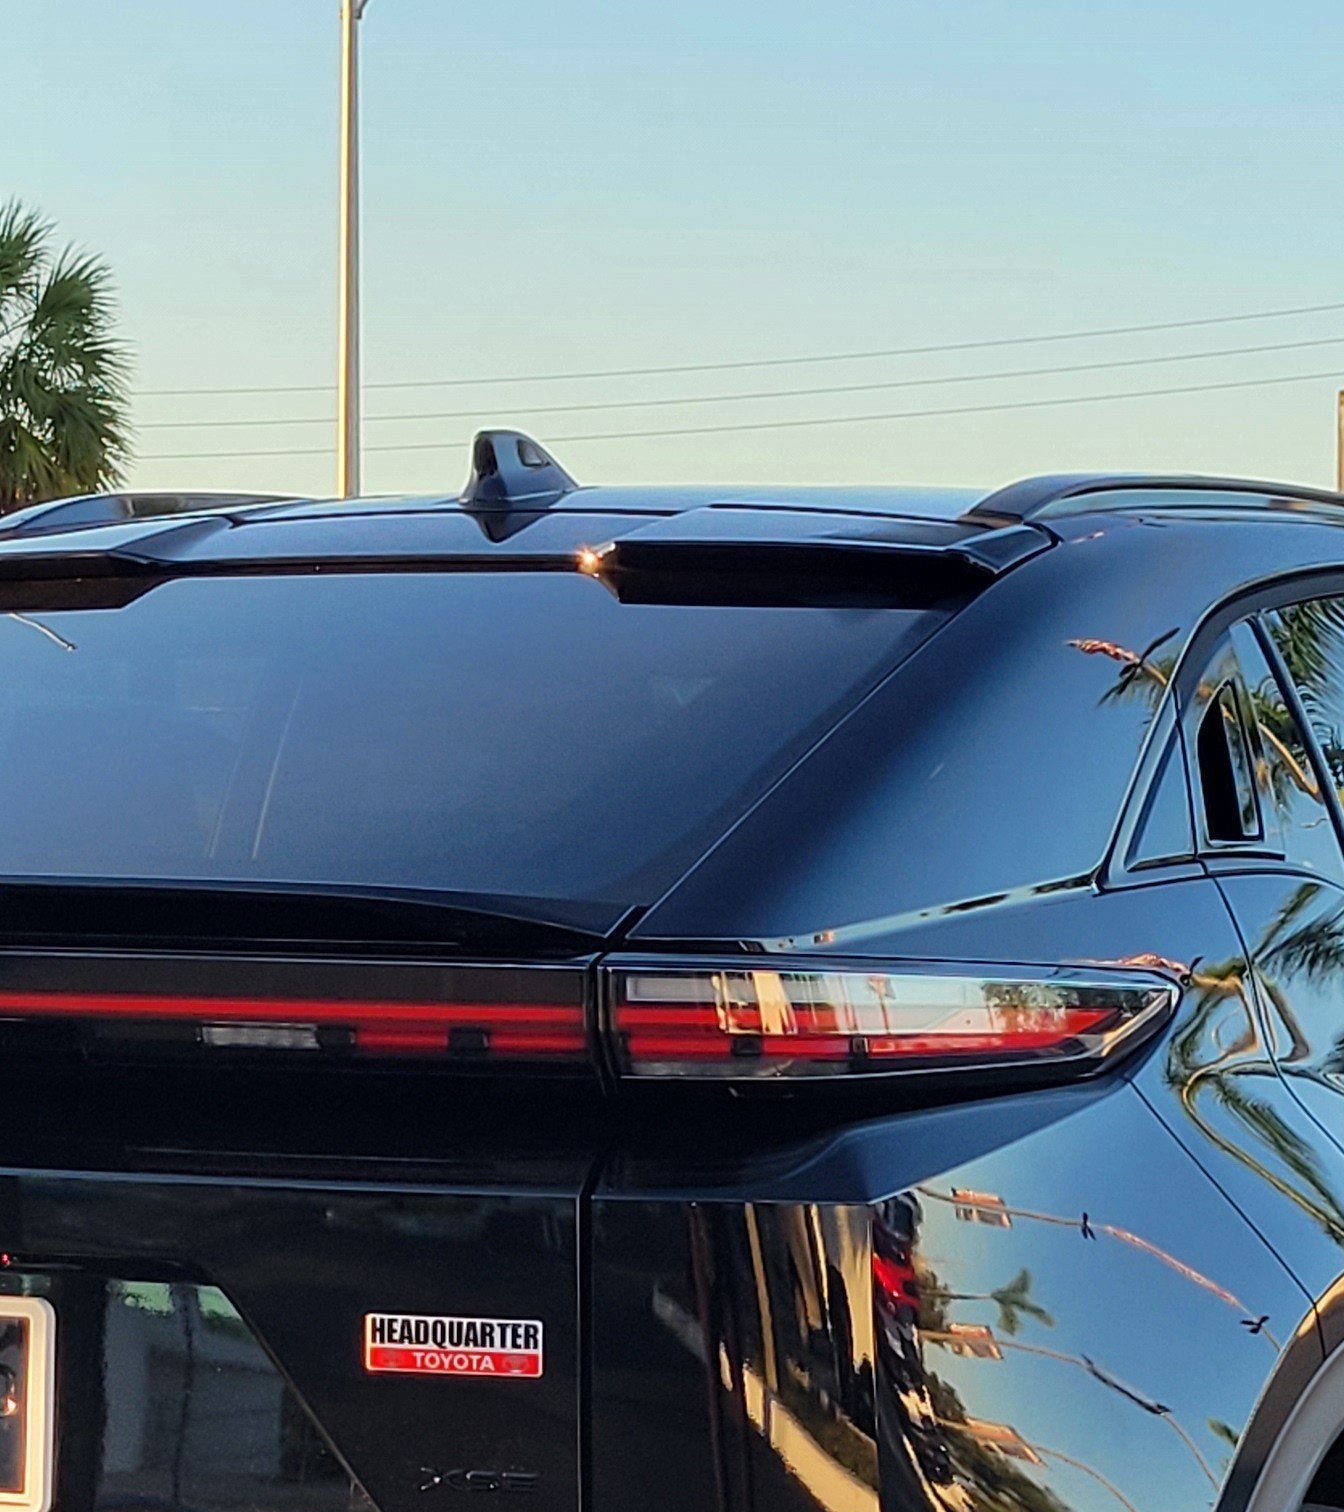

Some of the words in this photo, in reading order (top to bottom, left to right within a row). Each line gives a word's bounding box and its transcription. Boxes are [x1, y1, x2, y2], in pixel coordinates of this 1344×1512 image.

[371, 1317, 539, 1349] HEADQUARTER
[413, 1352, 495, 1372] TOYOTA
[419, 1466, 540, 1493] XSE
